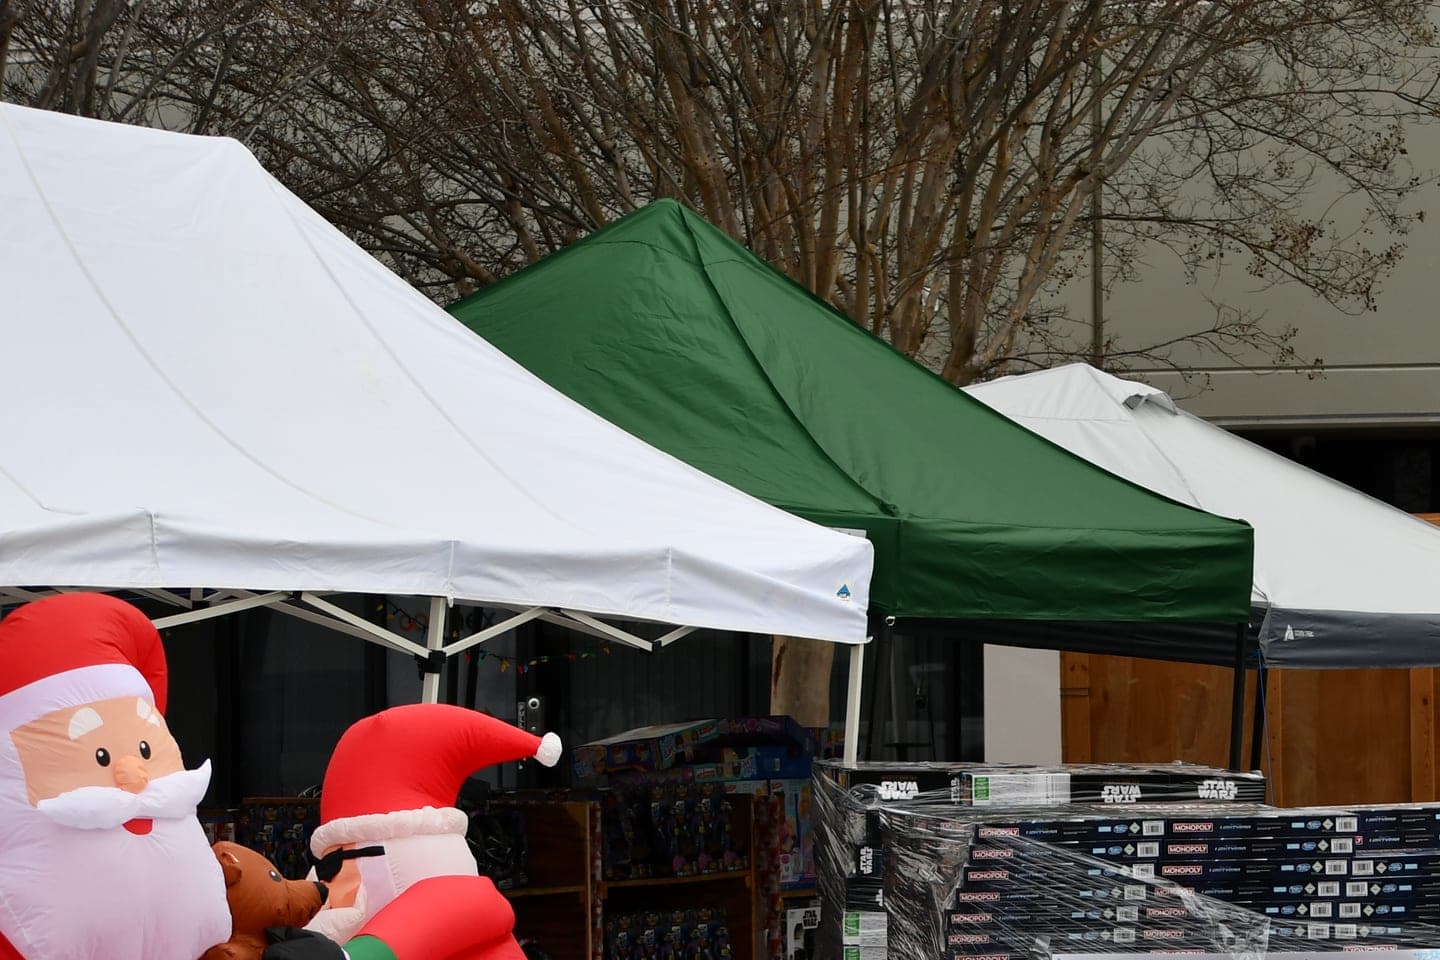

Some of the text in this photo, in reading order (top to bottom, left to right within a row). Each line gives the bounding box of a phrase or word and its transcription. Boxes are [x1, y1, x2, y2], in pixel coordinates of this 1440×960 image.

[1202, 780, 1236, 791] STAR
[1199, 788, 1237, 800] WARS
[1174, 823, 1212, 832] MONOPOLY
[1169, 845, 1207, 853] MONOPOLY
[860, 846, 868, 871] STAR
[865, 848, 873, 874] WARS
[1164, 866, 1201, 874] MONOPOLY
[970, 872, 1007, 880] MONOPOLY
